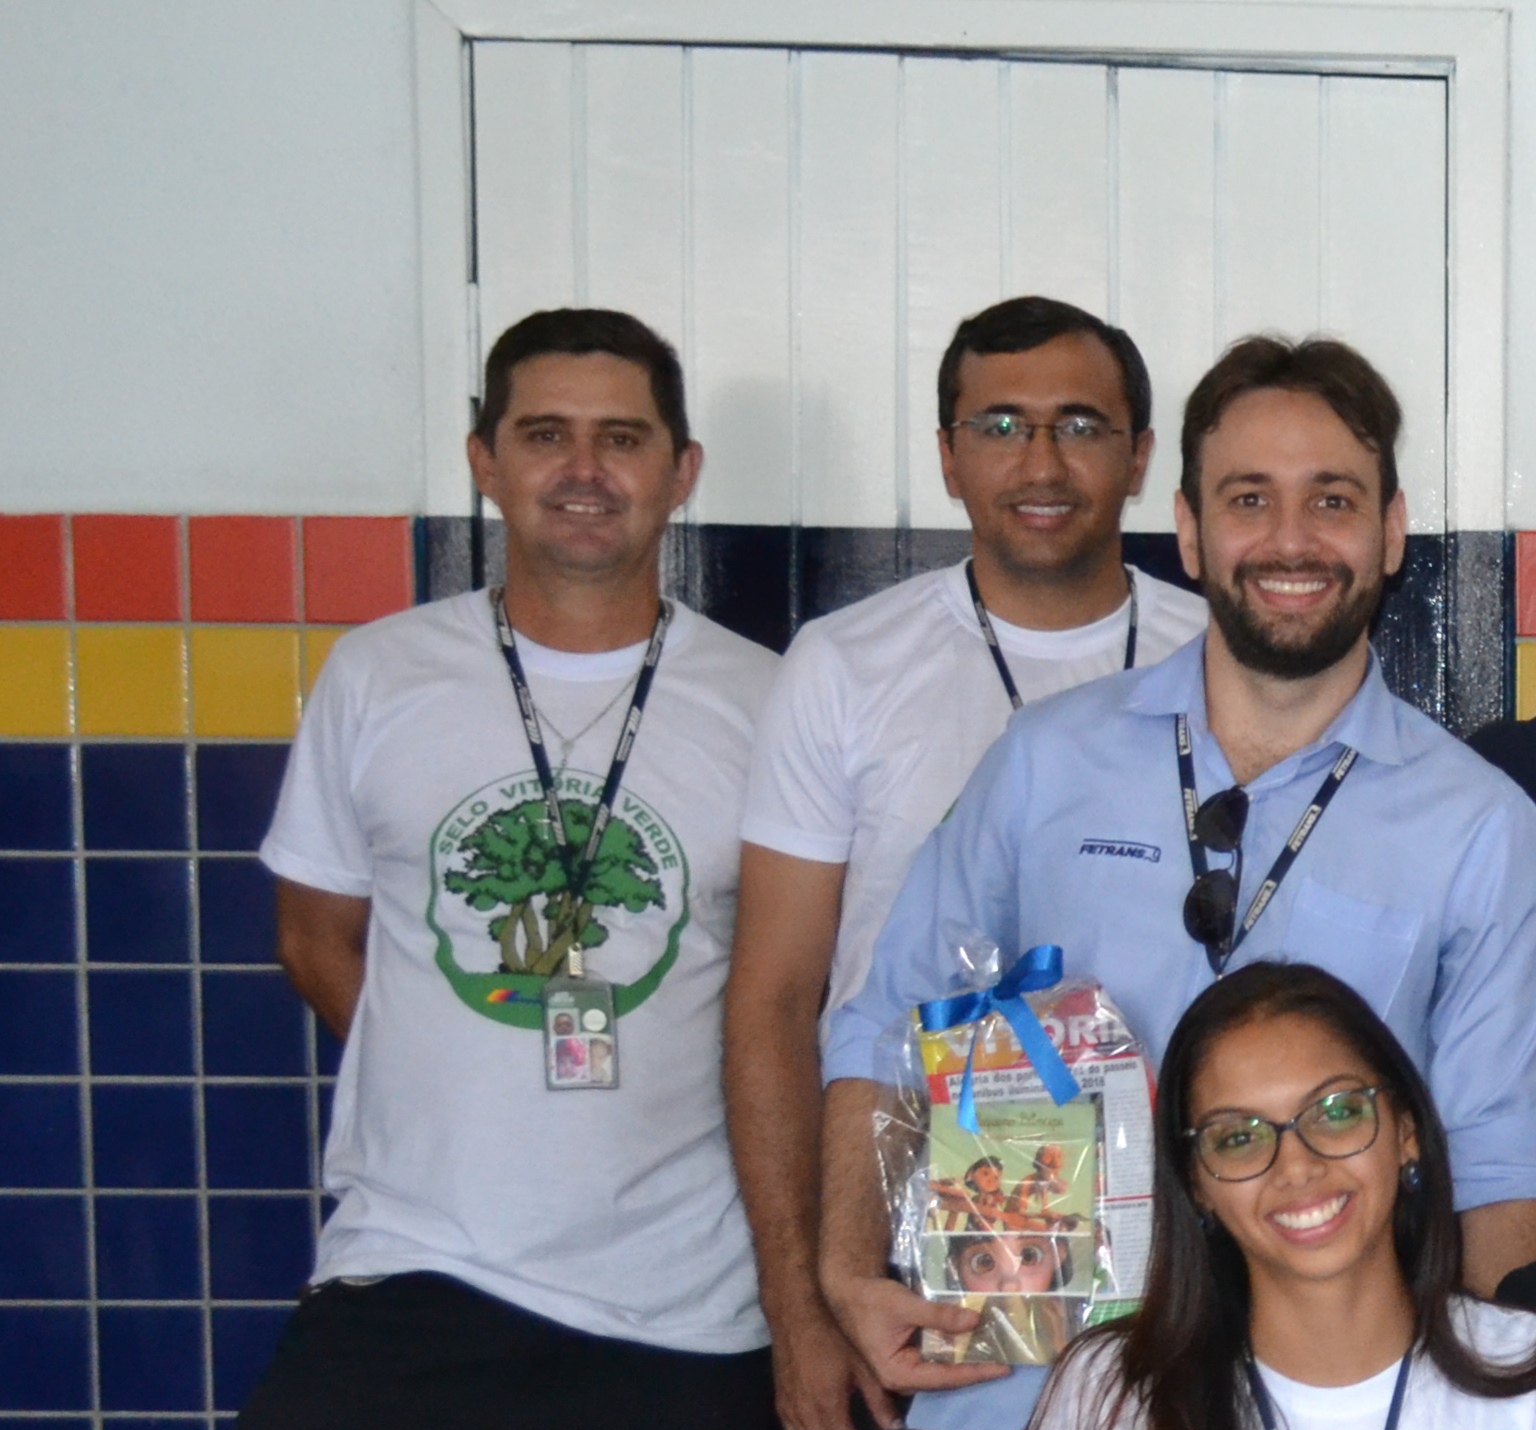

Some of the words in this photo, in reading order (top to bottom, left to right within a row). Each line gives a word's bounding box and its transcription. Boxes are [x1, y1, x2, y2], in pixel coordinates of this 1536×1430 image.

[439, 800, 489, 856] SELO
[621, 798, 679, 871] VERDE
[1079, 843, 1147, 859] FETRANS
